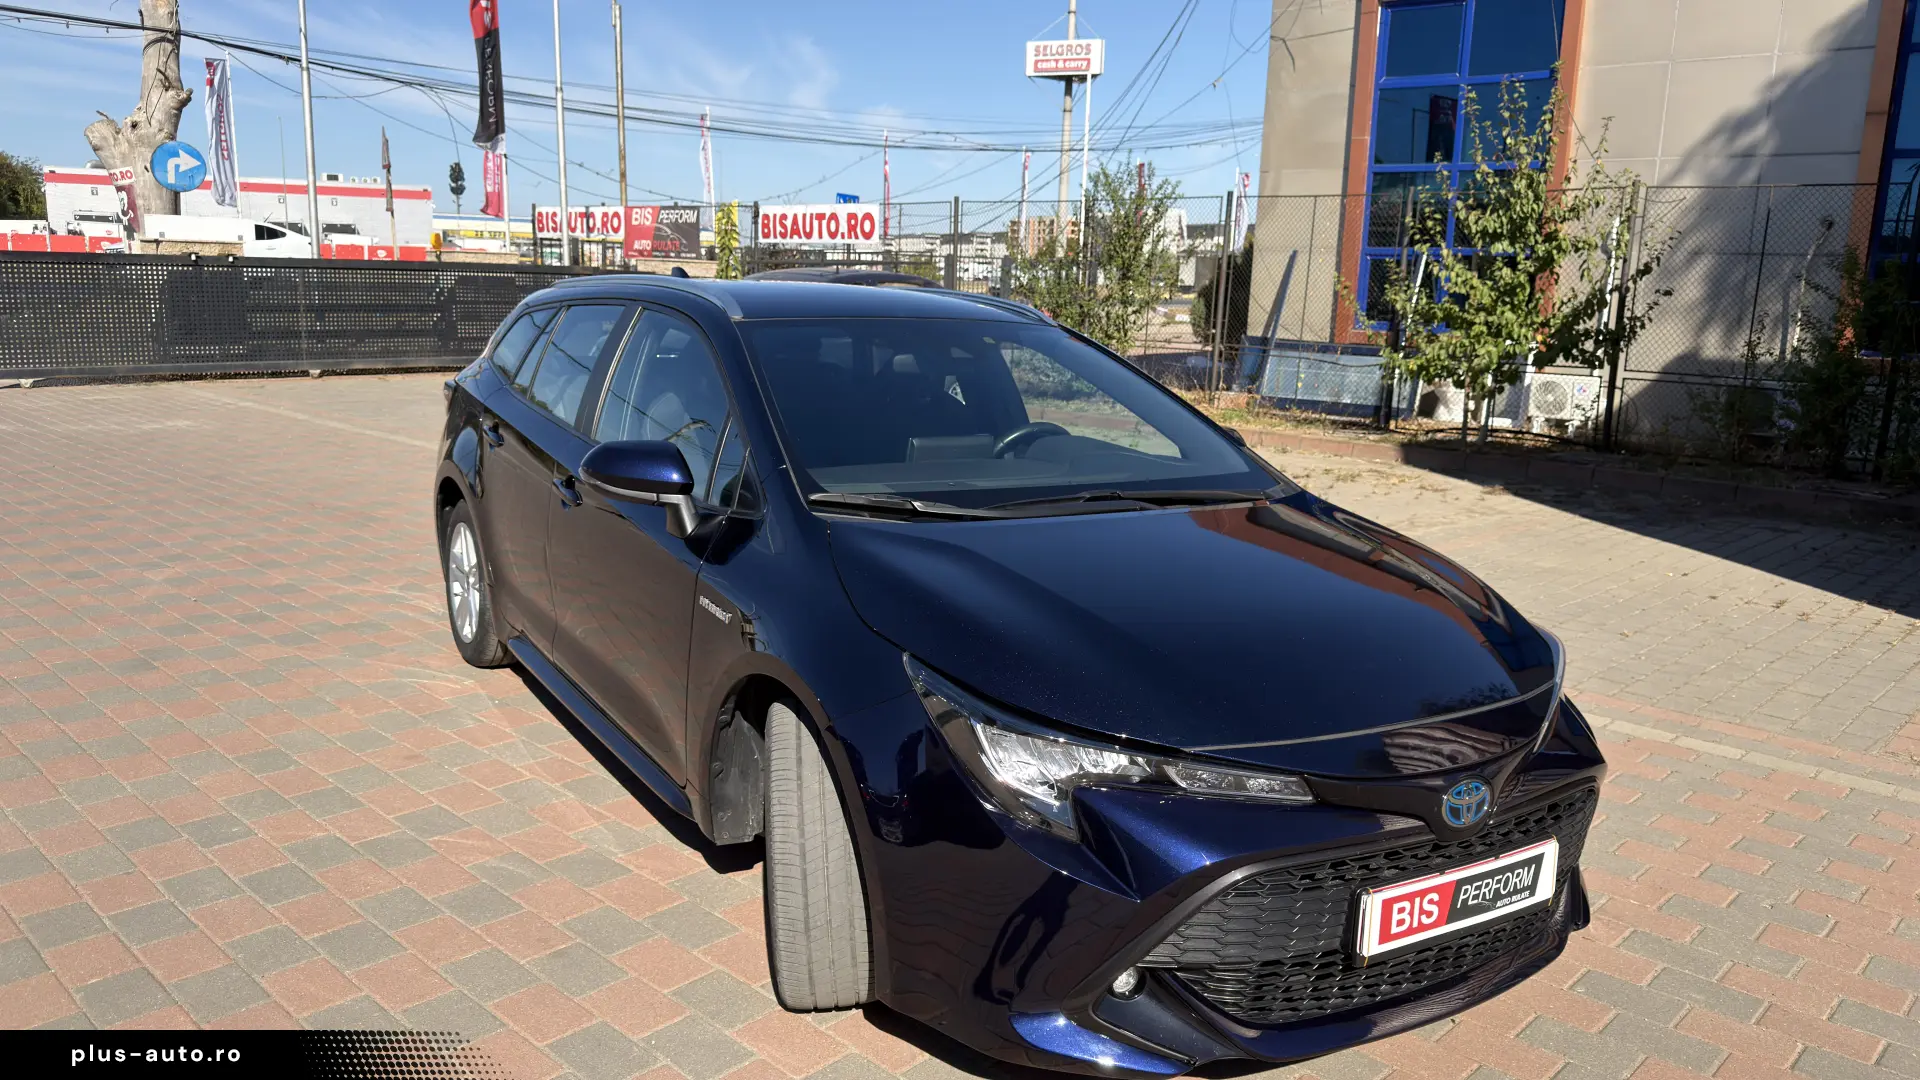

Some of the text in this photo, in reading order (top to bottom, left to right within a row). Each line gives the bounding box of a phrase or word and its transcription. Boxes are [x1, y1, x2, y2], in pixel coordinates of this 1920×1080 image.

[1034, 43, 1092, 57] SELGROS
[1037, 60, 1088, 70] cash & carry
[536, 211, 622, 234] BISUTO.RO
[631, 207, 698, 226] BIS PERFORM
[761, 212, 876, 241] BISAUTO.RO
[633, 239, 652, 251] AUTO
[1390, 863, 1536, 935] BIS PERFORM
[1495, 890, 1531, 908] AUTO RULATE
